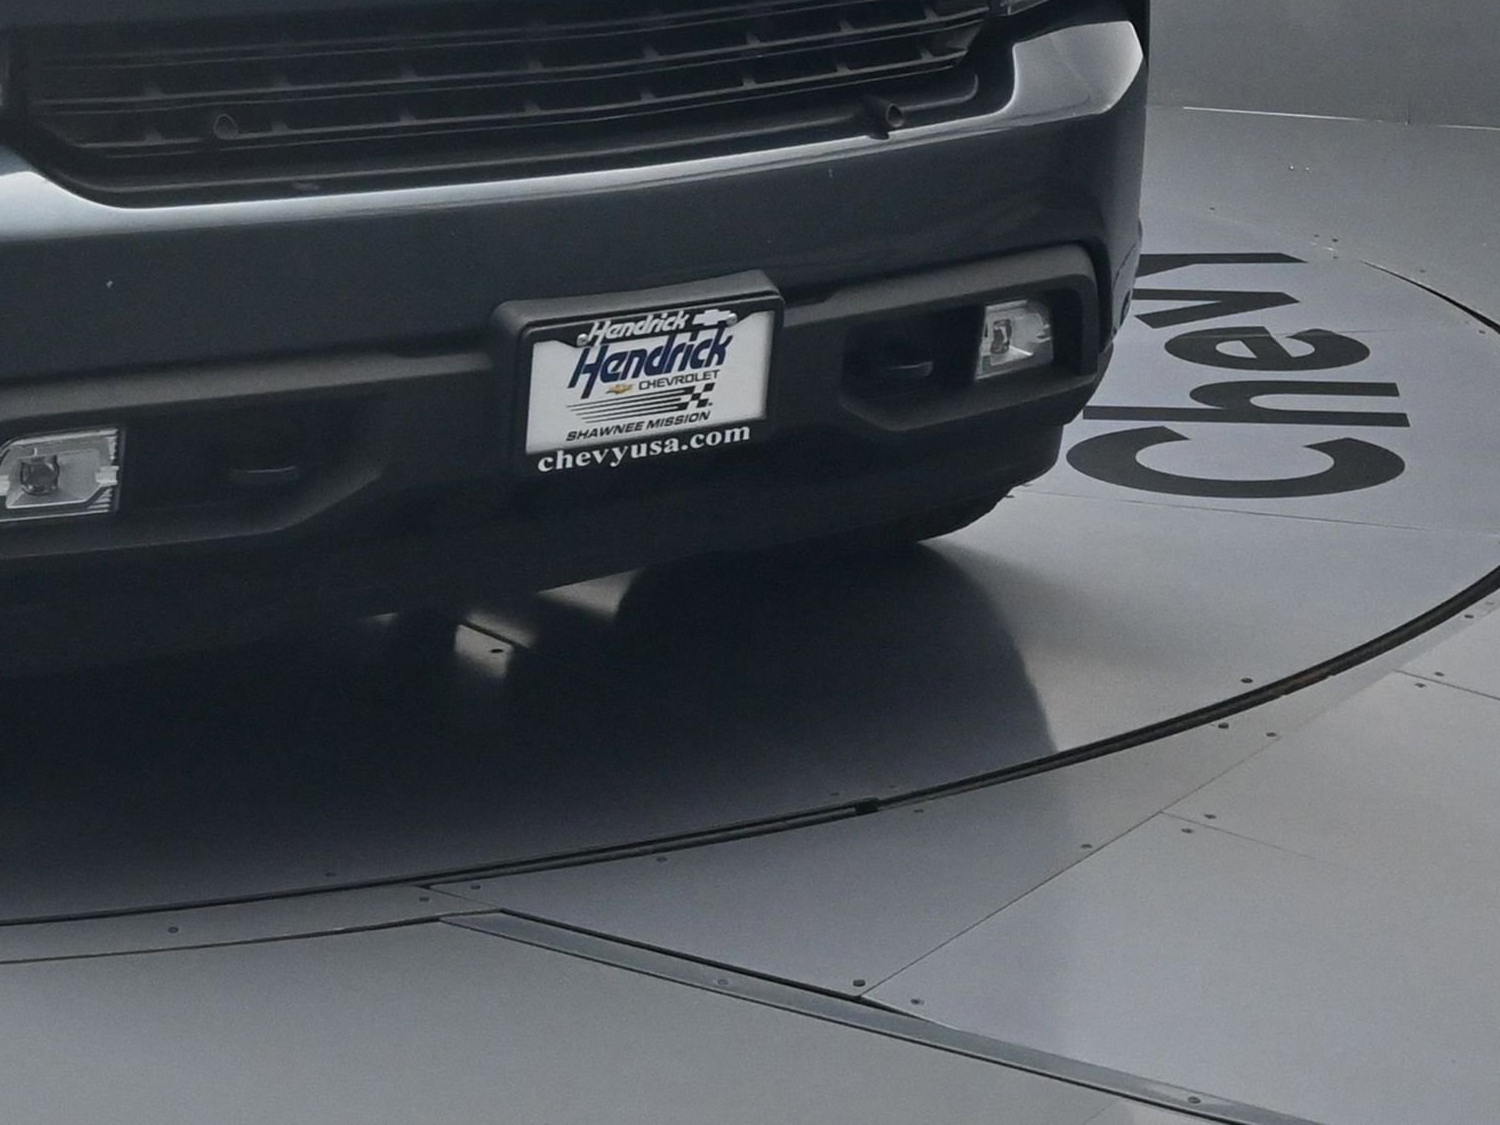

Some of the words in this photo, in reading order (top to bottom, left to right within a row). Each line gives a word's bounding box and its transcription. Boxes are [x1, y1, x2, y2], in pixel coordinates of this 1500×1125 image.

[586, 310, 690, 346] Hendrick
[567, 326, 733, 400] Hendrick
[638, 369, 721, 391] CHEVROLET
[565, 421, 644, 442] SHAWNEE
[646, 410, 711, 431] MISSION
[537, 426, 751, 473] chevyusa.com
